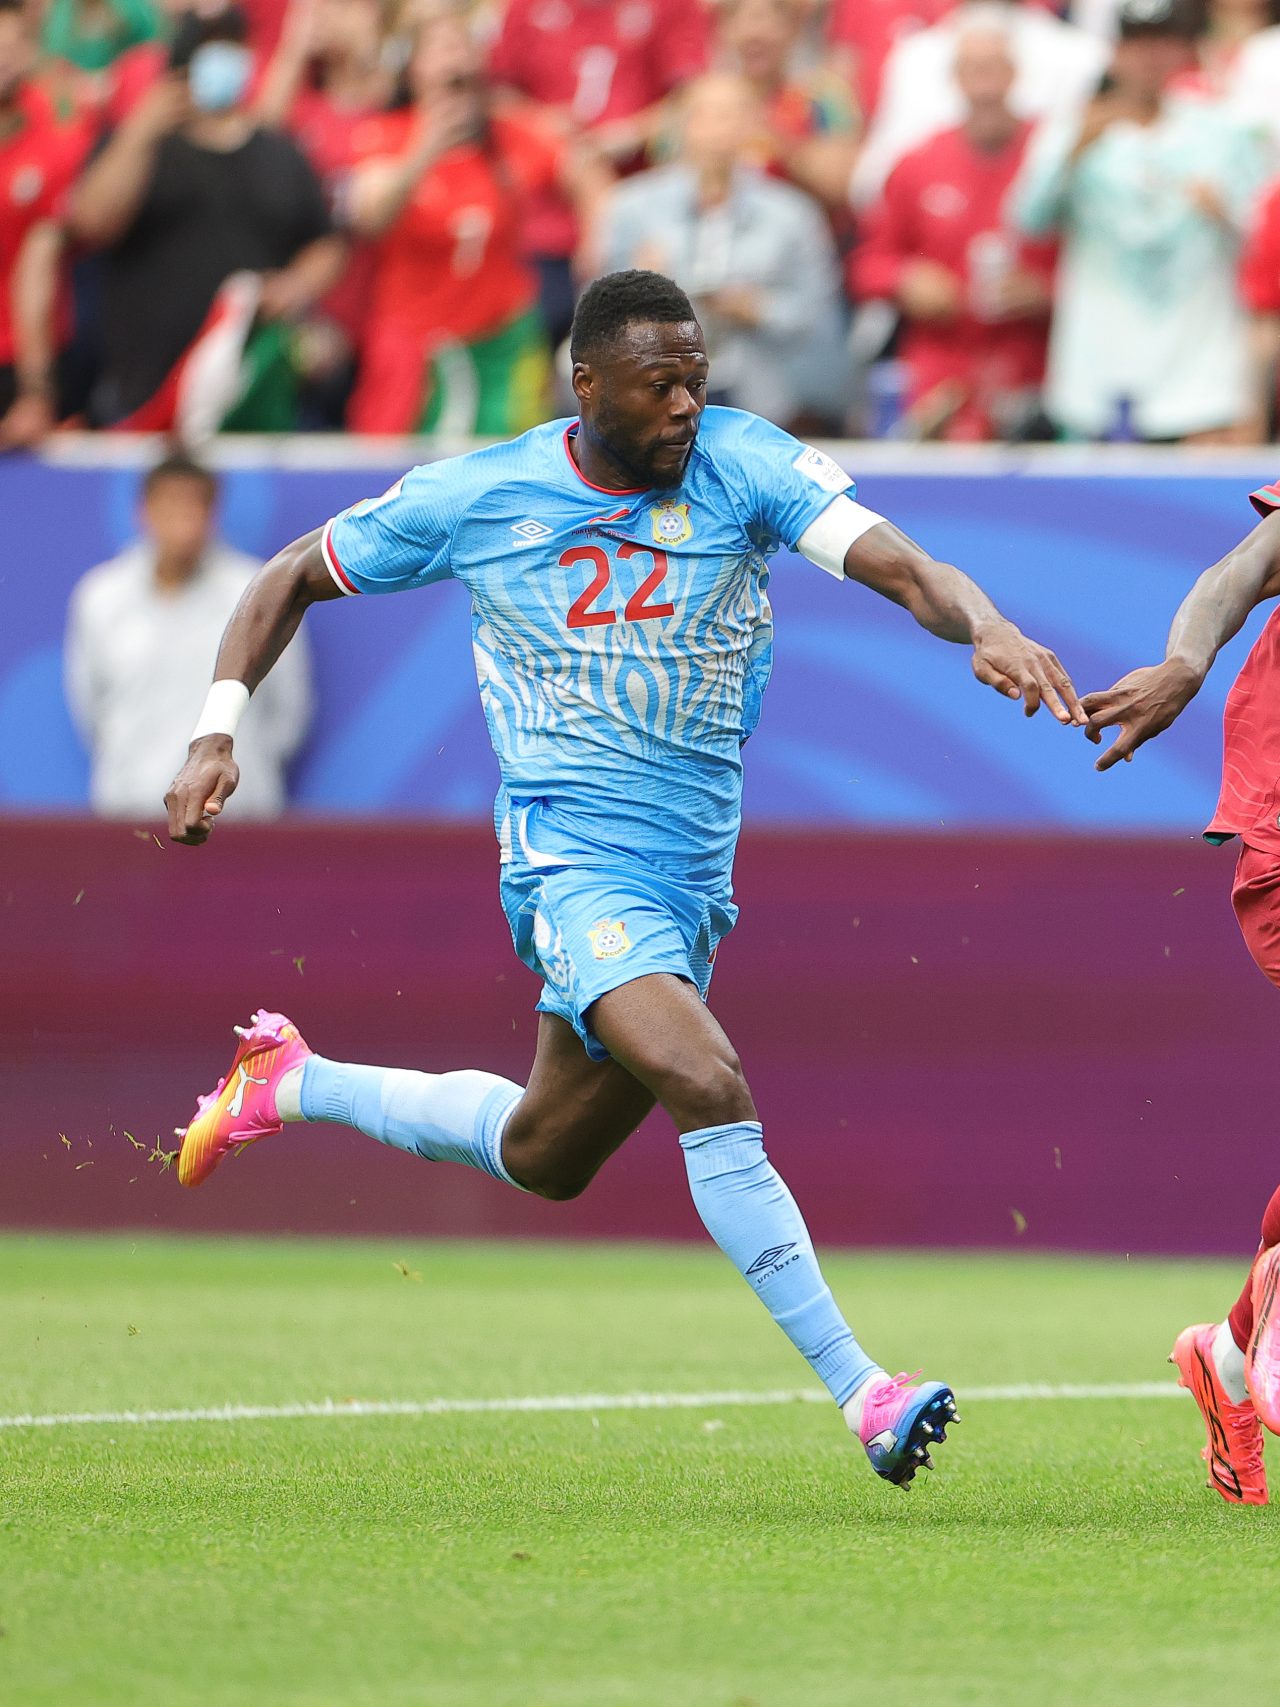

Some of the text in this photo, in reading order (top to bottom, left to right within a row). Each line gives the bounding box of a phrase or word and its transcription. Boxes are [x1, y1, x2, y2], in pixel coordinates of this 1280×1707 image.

[659, 533, 686, 543] FECOFA
[558, 543, 676, 629] 22
[757, 1254, 800, 1284] umbro
